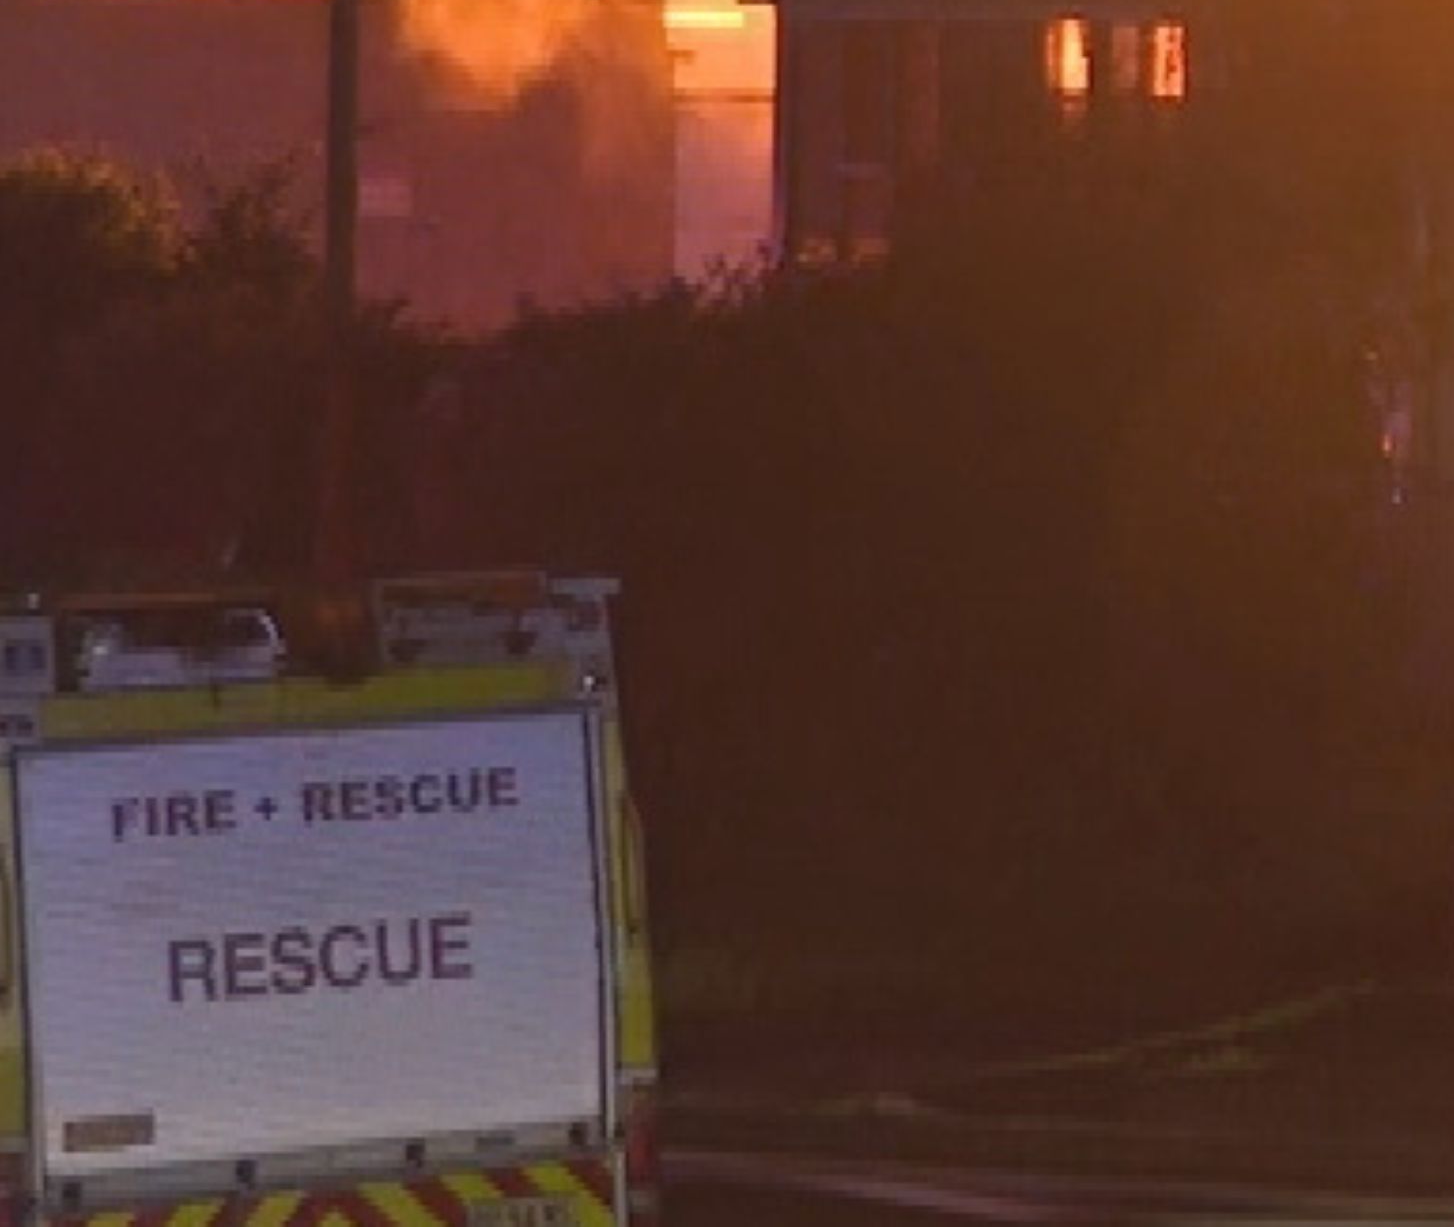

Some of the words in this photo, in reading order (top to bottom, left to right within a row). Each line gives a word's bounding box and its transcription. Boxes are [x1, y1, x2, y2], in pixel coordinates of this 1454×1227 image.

[111, 789, 237, 842] FIRE
[302, 766, 519, 824] RESCUE
[167, 910, 474, 1003] RESCUE
